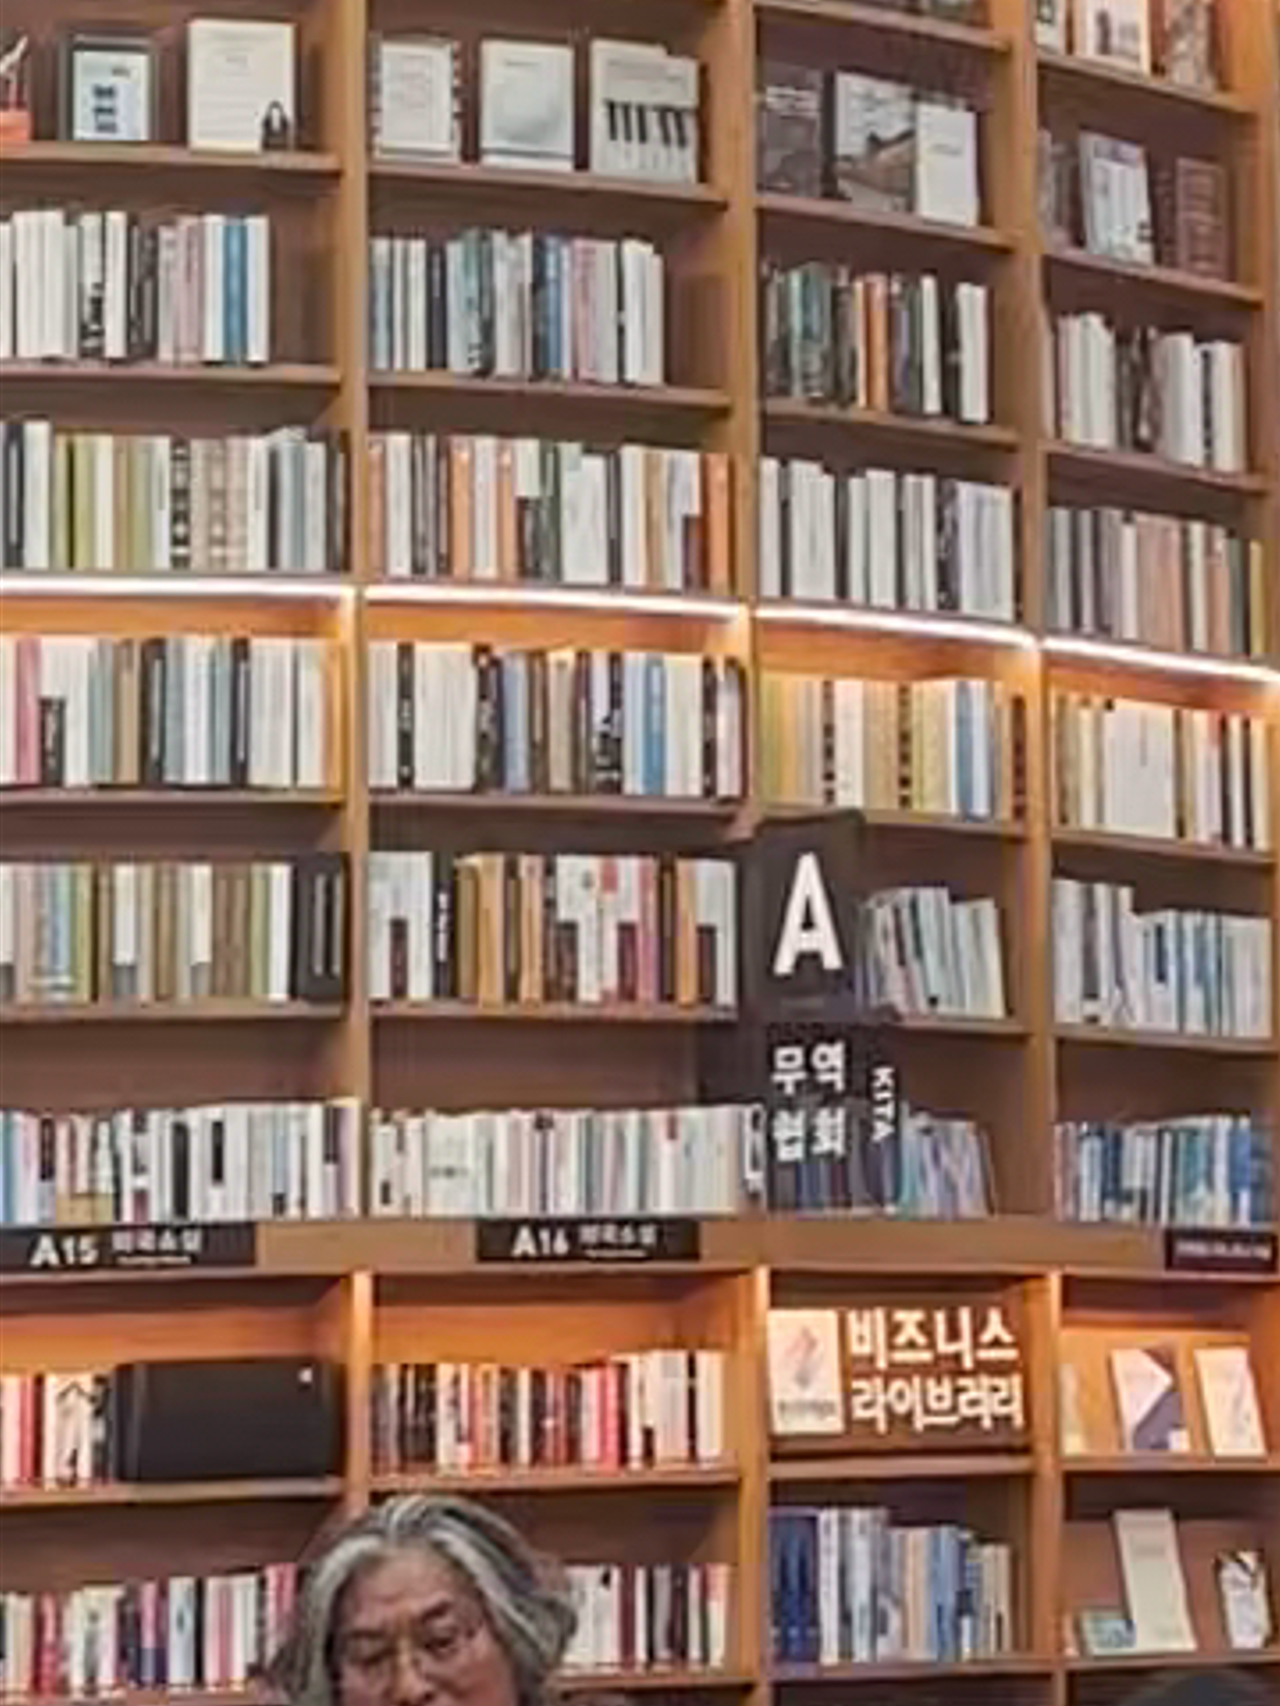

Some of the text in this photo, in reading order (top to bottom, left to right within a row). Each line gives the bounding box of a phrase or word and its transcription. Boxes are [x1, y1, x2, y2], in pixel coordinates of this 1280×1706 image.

[773, 851, 843, 975] A
[771, 1041, 846, 1095] 무역
[872, 1066, 896, 1143] KITA
[848, 1307, 1019, 1371] 비즈니스
[851, 1374, 1024, 1435] 라이브러리
